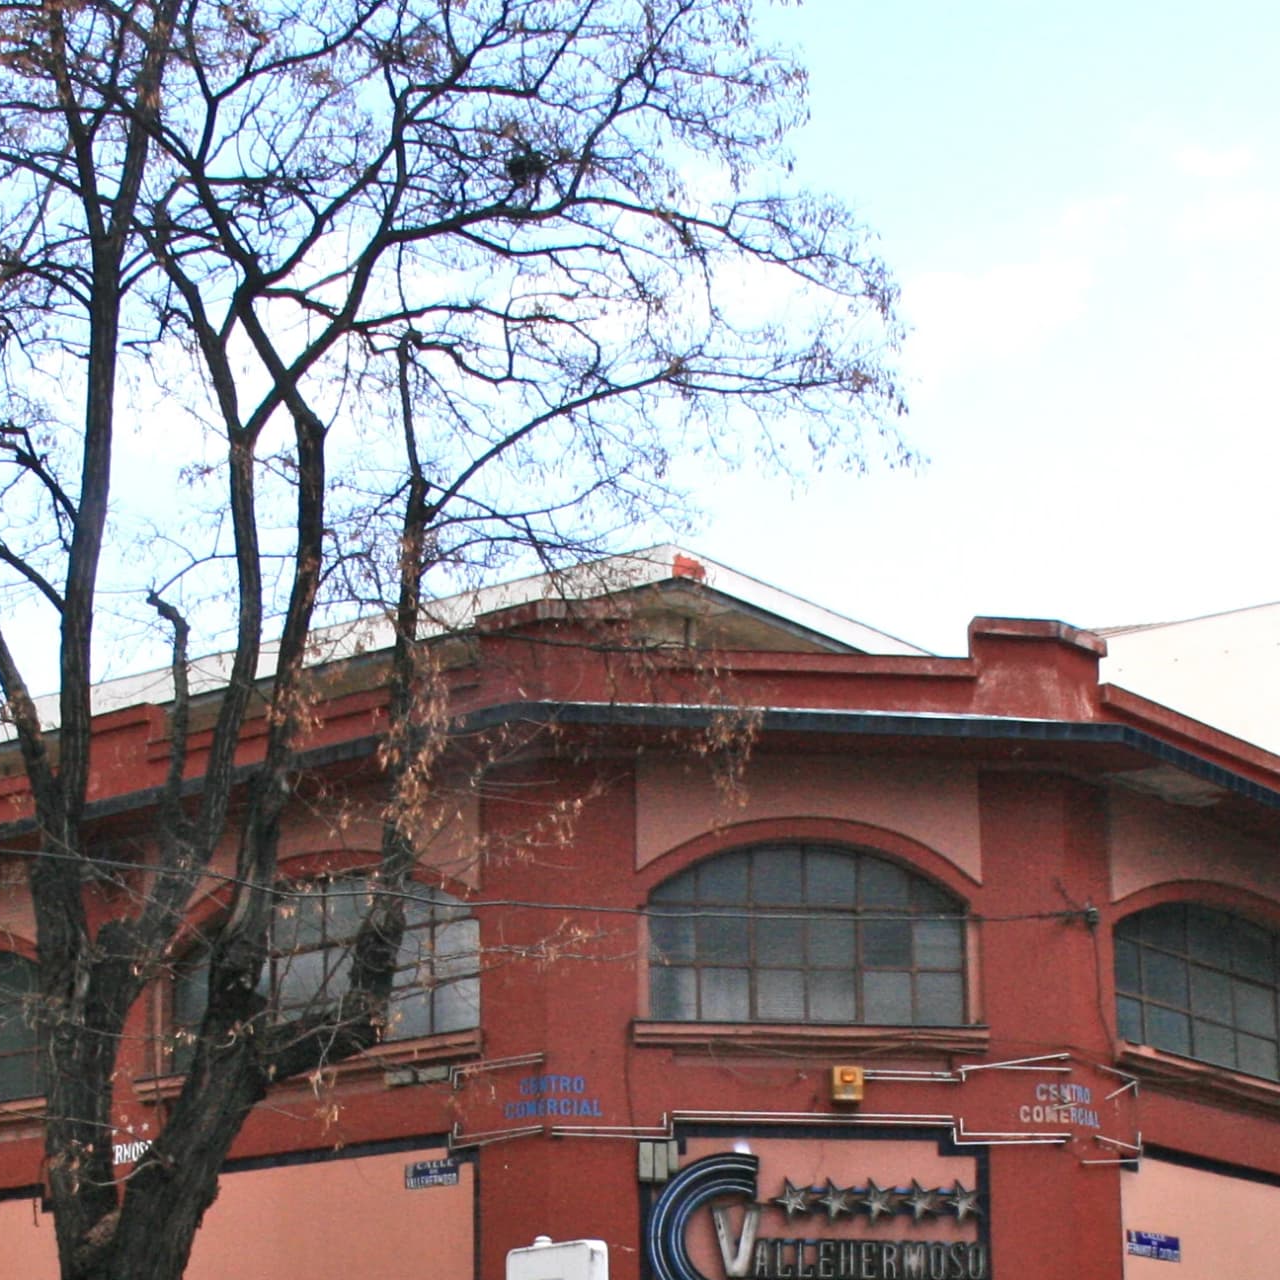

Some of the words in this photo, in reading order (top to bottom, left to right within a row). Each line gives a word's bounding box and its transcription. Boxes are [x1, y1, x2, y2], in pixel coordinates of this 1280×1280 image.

[520, 1075, 585, 1095] CENTRO
[504, 1097, 602, 1119] COMERCIAL
[1020, 1105, 1100, 1128] COMERCIAL
[711, 1203, 986, 1280] VALLEHERMOSO
